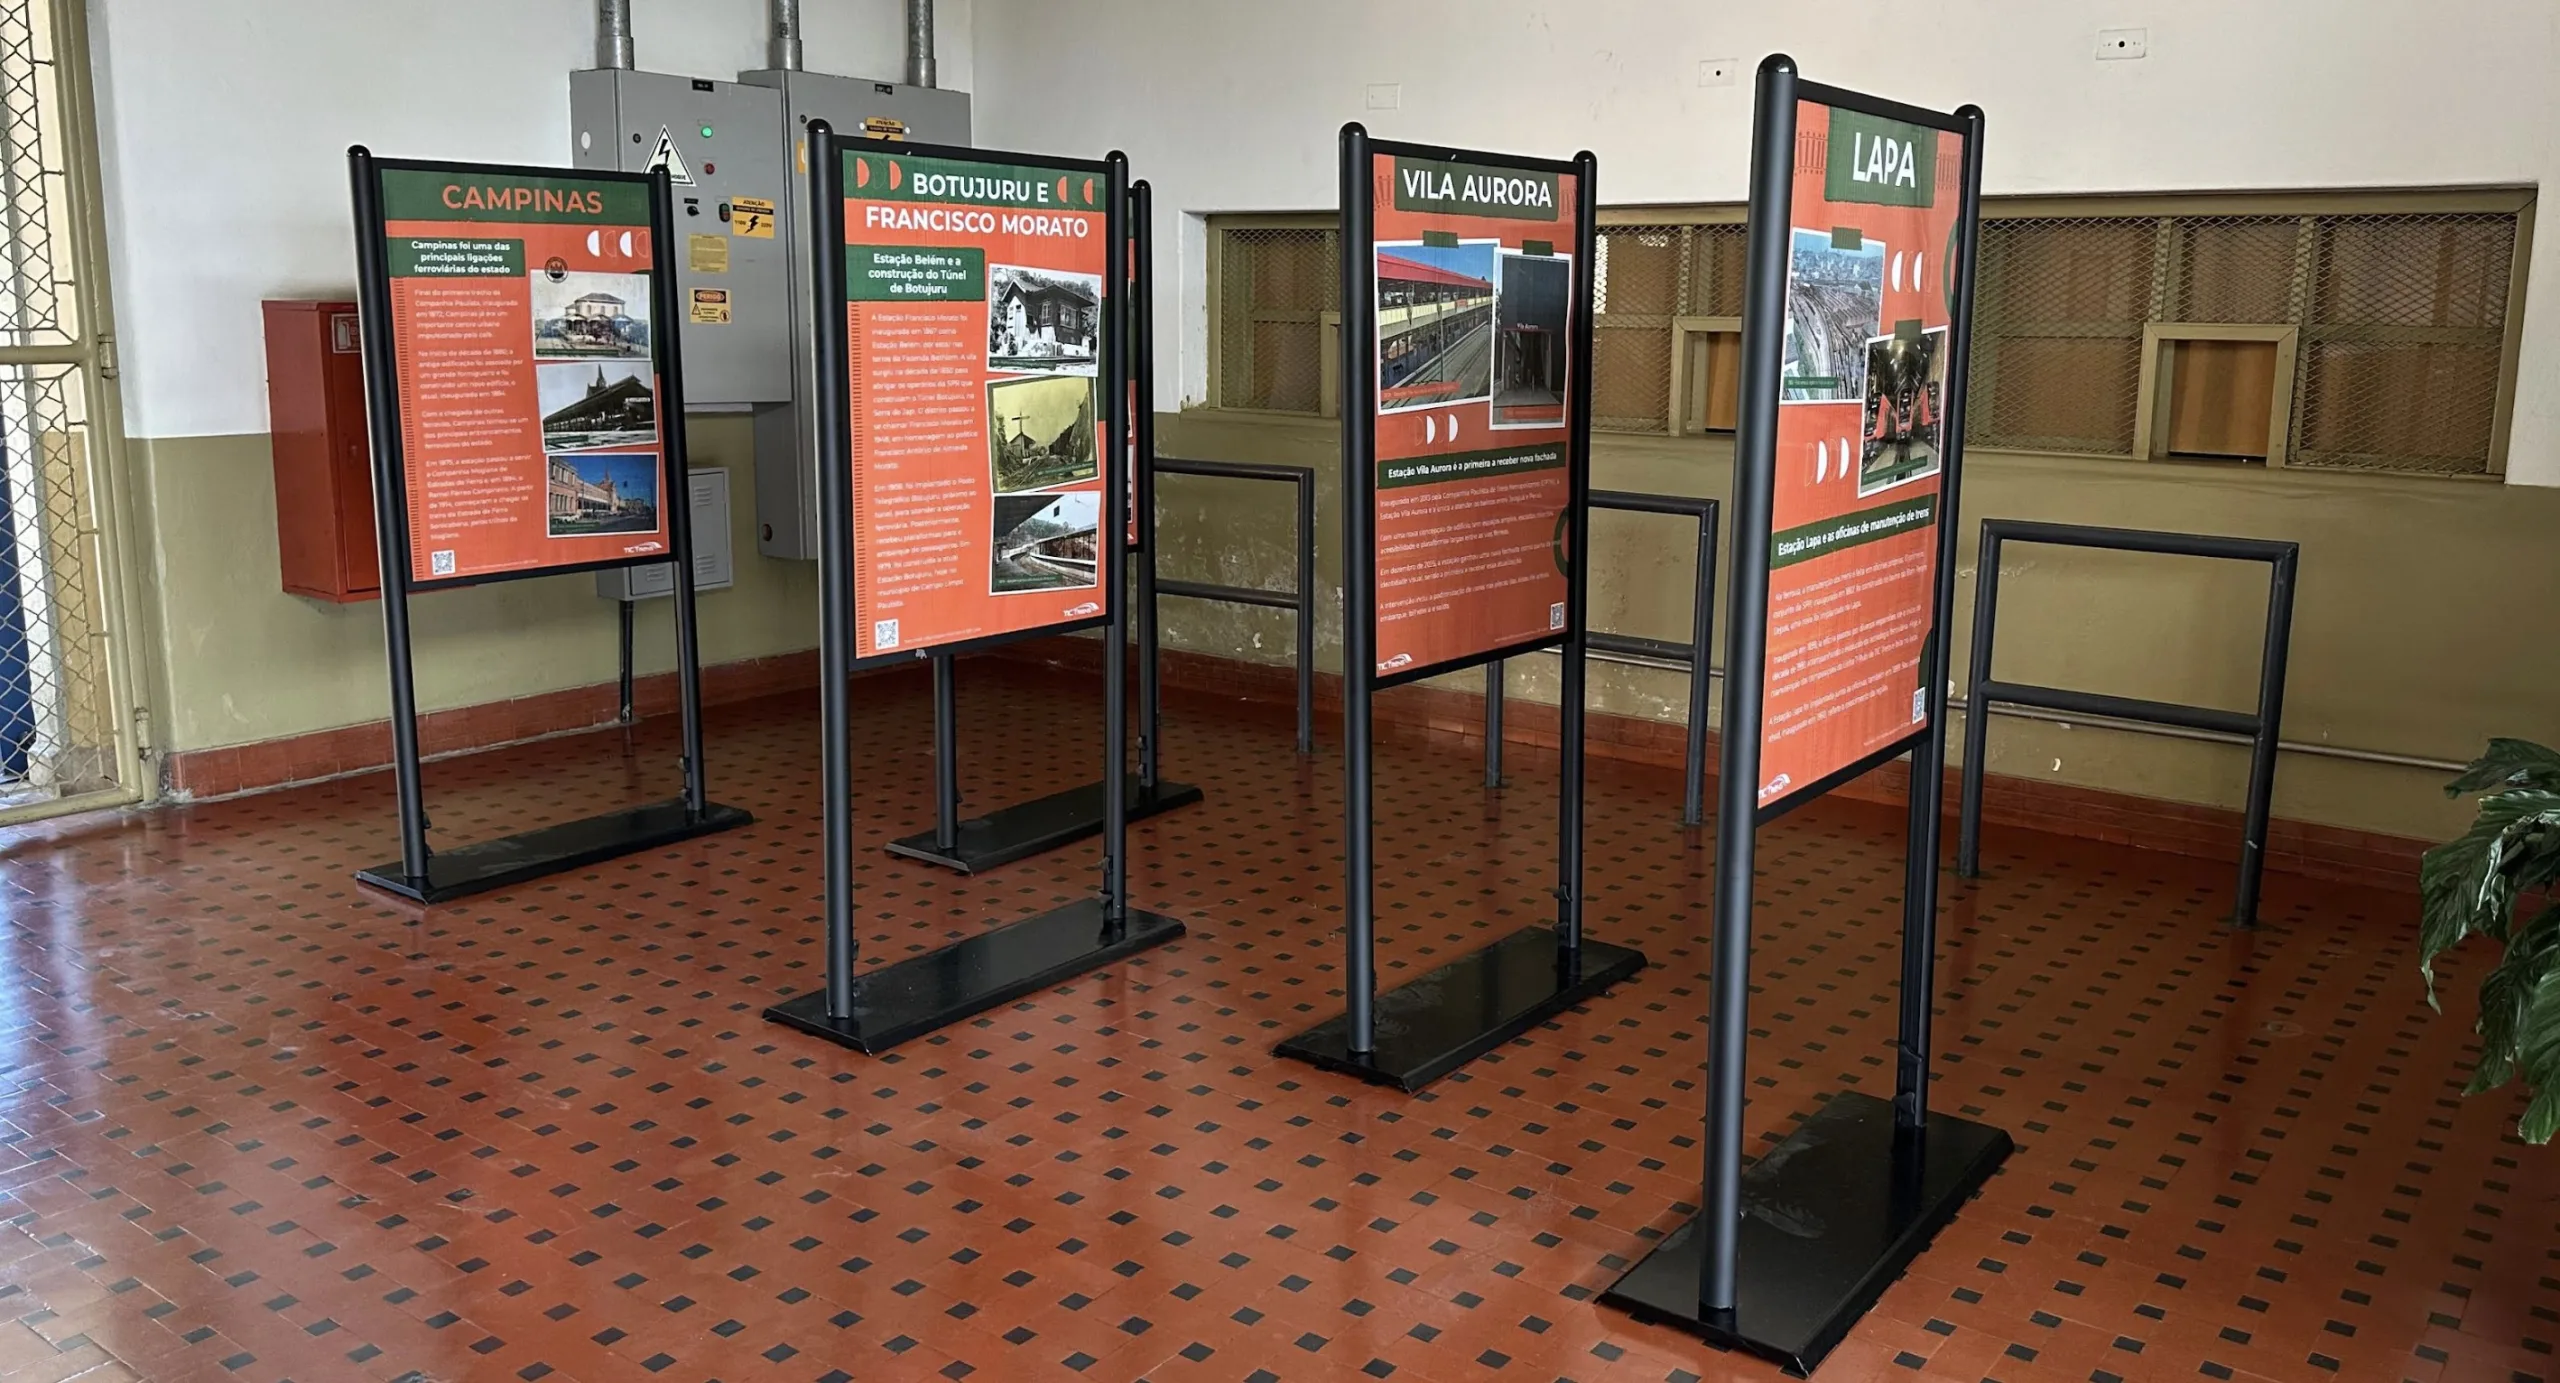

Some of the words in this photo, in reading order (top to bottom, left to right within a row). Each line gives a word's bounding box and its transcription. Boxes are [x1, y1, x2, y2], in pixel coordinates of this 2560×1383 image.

[1852, 133, 1918, 187] LAPA
[441, 185, 603, 213] CAMPINAS
[912, 173, 1030, 201] BOTUJURU
[1037, 182, 1048, 203] E
[1402, 168, 1455, 200] VILA
[1461, 174, 1552, 207] AURORA
[865, 205, 995, 233] FRANCISCO
[1001, 213, 1088, 238] MORATO
[411, 240, 457, 251] Campinas
[458, 241, 470, 249] foi
[494, 241, 509, 250] das
[420, 253, 465, 263] principais
[466, 253, 502, 263] ligações
[413, 264, 466, 273] ferroviárias
[467, 265, 479, 273] do
[480, 265, 510, 273] estado
[873, 252, 912, 266] Estação
[914, 254, 944, 265] Belém
[947, 257, 953, 265] e
[955, 257, 961, 266] a
[868, 268, 923, 281] construção
[925, 269, 938, 279] do
[940, 270, 966, 280] Túnel
[890, 282, 902, 293] de
[905, 283, 947, 296] Botujuru
[1388, 466, 1414, 478] Estação
[1416, 465, 1429, 474] Vila
[1430, 464, 1452, 473] Aurora
[1453, 462, 1457, 471] é
[1463, 459, 1490, 472] primeira
[1496, 456, 1518, 466] receber
[1519, 455, 1533, 463] nova
[1534, 452, 1556, 462] fachada
[1777, 538, 1804, 555] Estação
[1805, 536, 1821, 550] Lapa
[1821, 534, 1827, 543] e
[1826, 532, 1835, 543] as
[1835, 526, 1859, 539] oficinas
[1860, 521, 1869, 534] de
[1869, 513, 1906, 530] manutenção
[1906, 511, 1914, 521] de
[1914, 508, 1930, 519] trens
